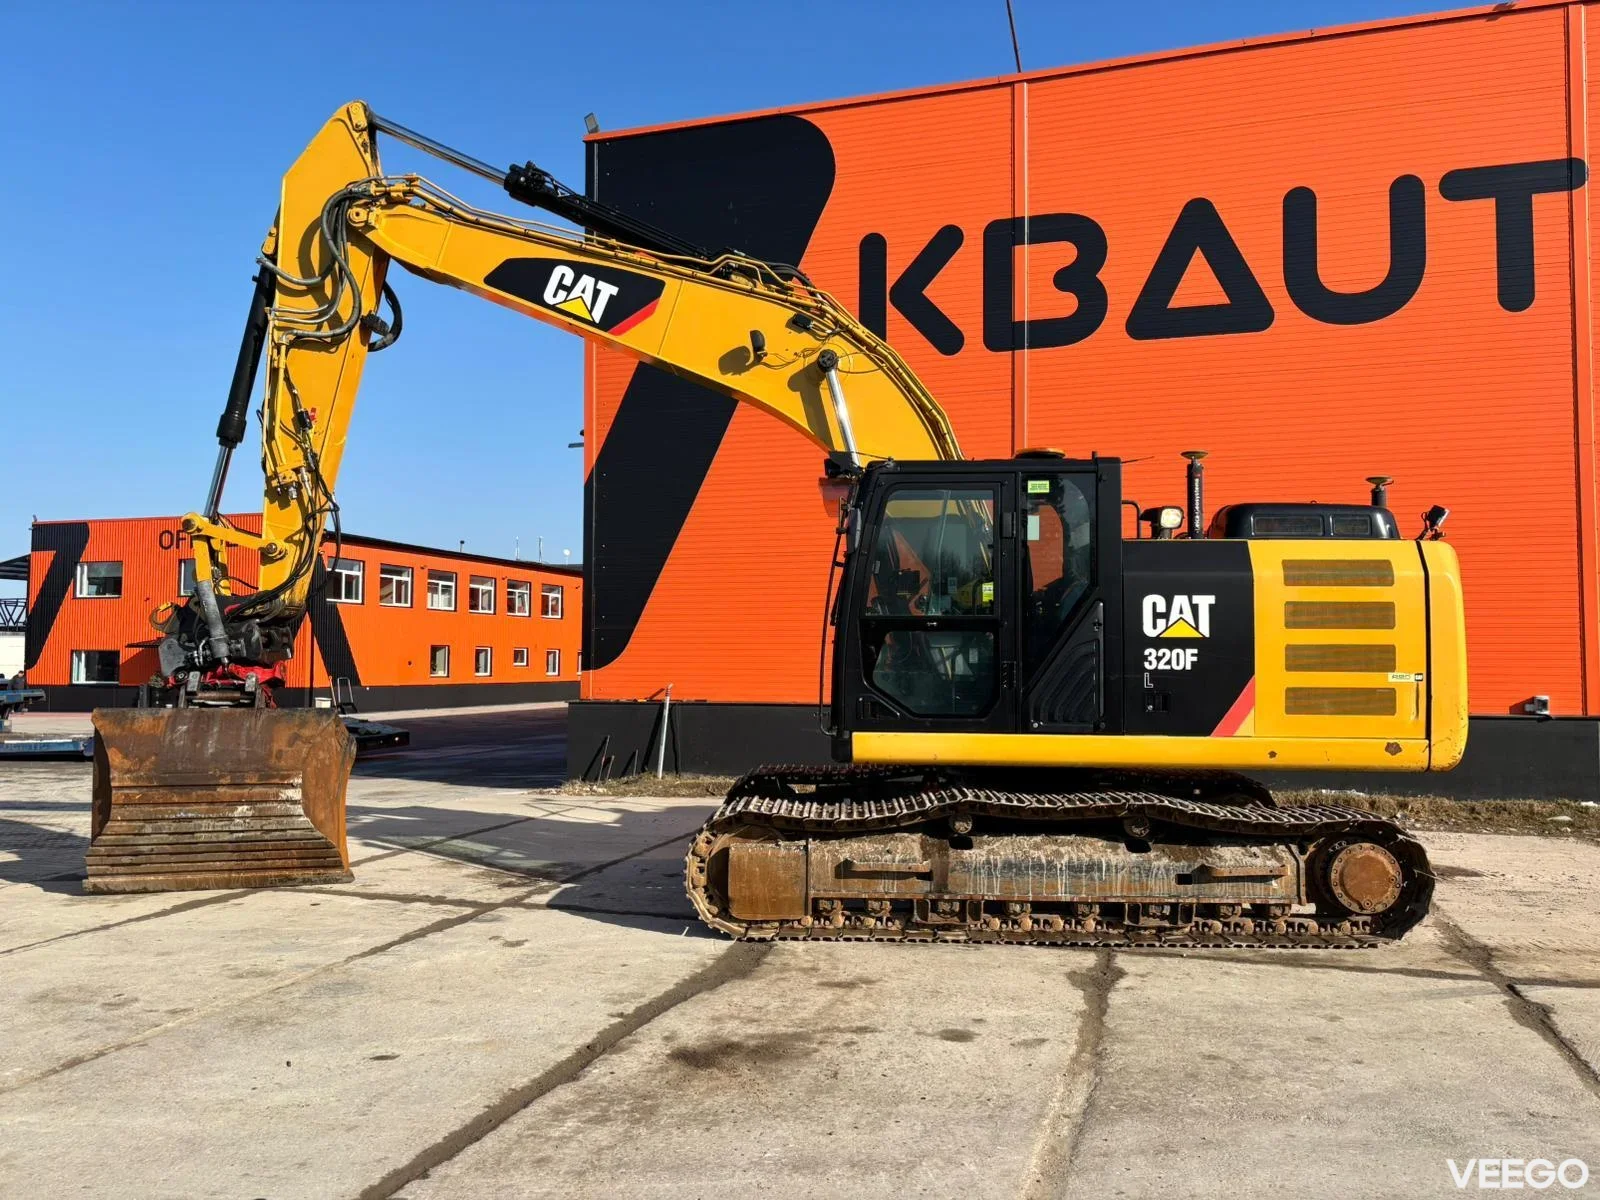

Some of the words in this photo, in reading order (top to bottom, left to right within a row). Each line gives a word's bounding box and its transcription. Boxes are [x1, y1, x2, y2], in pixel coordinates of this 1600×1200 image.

[859, 157, 1587, 356] KBAUT
[543, 265, 620, 324] CAT
[1142, 594, 1216, 638] CAT
[1144, 648, 1198, 670] 320F
[1144, 672, 1154, 688] L
